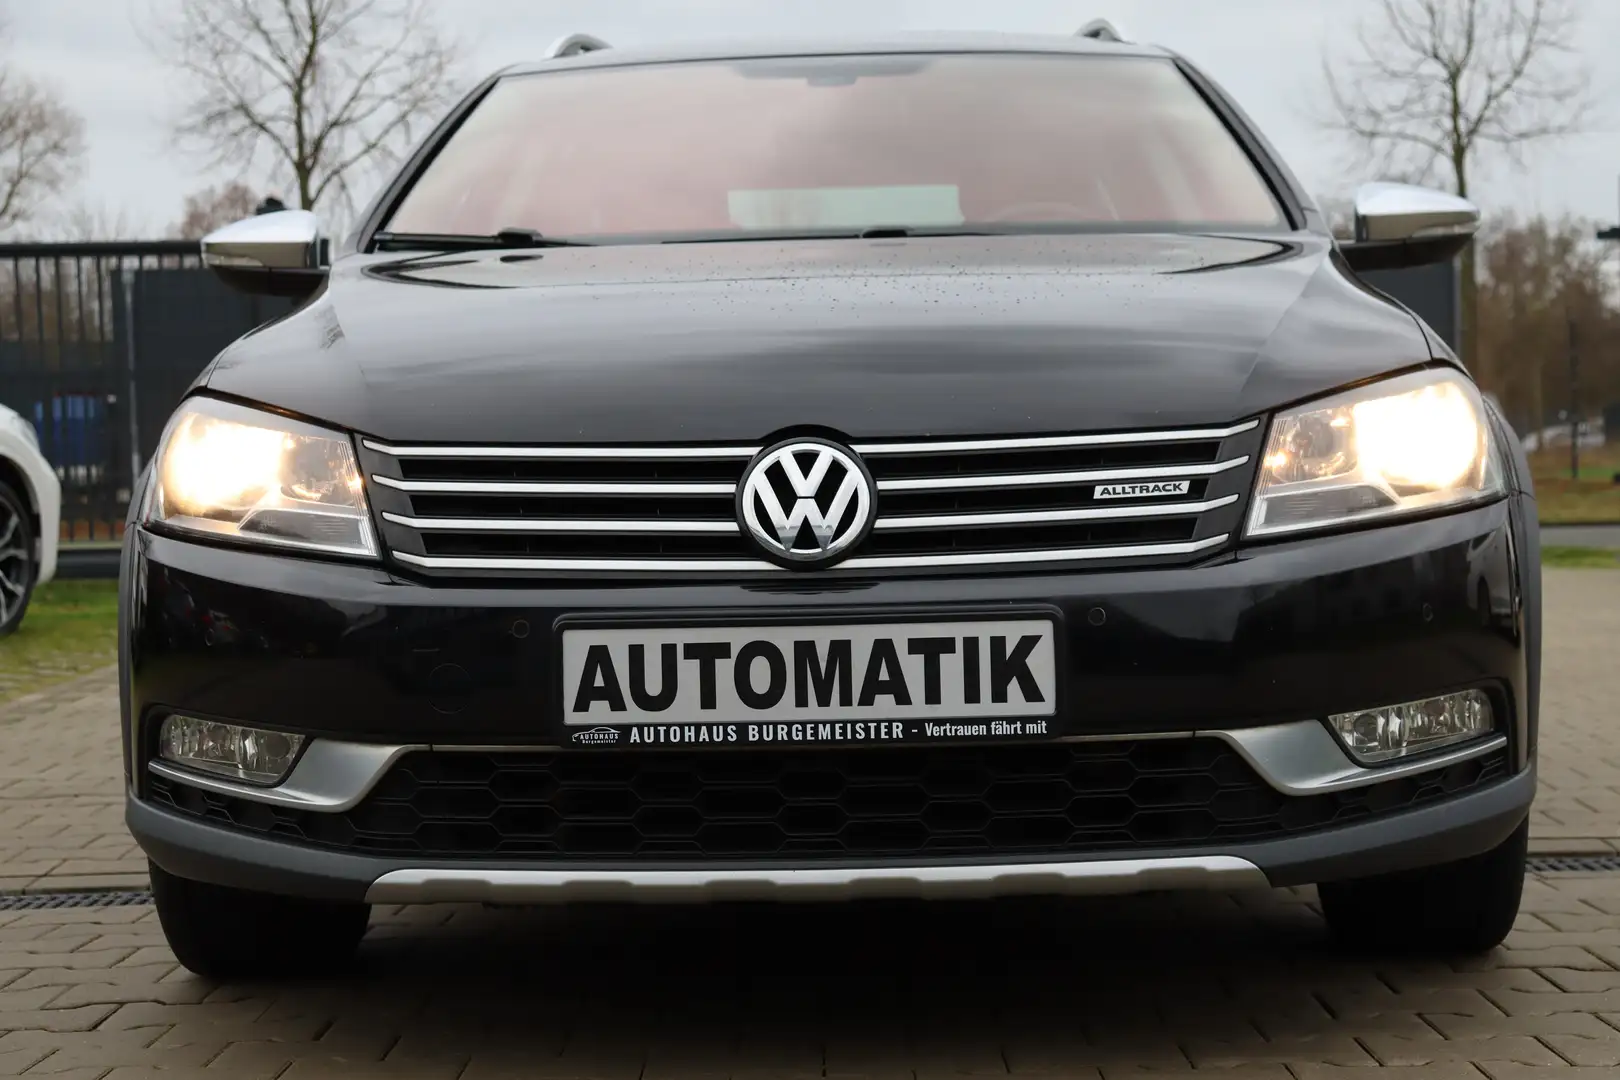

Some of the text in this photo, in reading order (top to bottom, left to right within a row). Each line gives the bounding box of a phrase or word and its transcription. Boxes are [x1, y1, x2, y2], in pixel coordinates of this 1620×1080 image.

[1100, 483, 1183, 496] ALLTRACK
[573, 634, 1046, 713] AUTOMATIK
[630, 725, 738, 743] AUTOHAUS
[748, 722, 904, 742] BURGEMEISTER
[925, 722, 987, 737] Vertrauen
[991, 720, 1022, 736] fährt
[1026, 719, 1047, 735] mit
